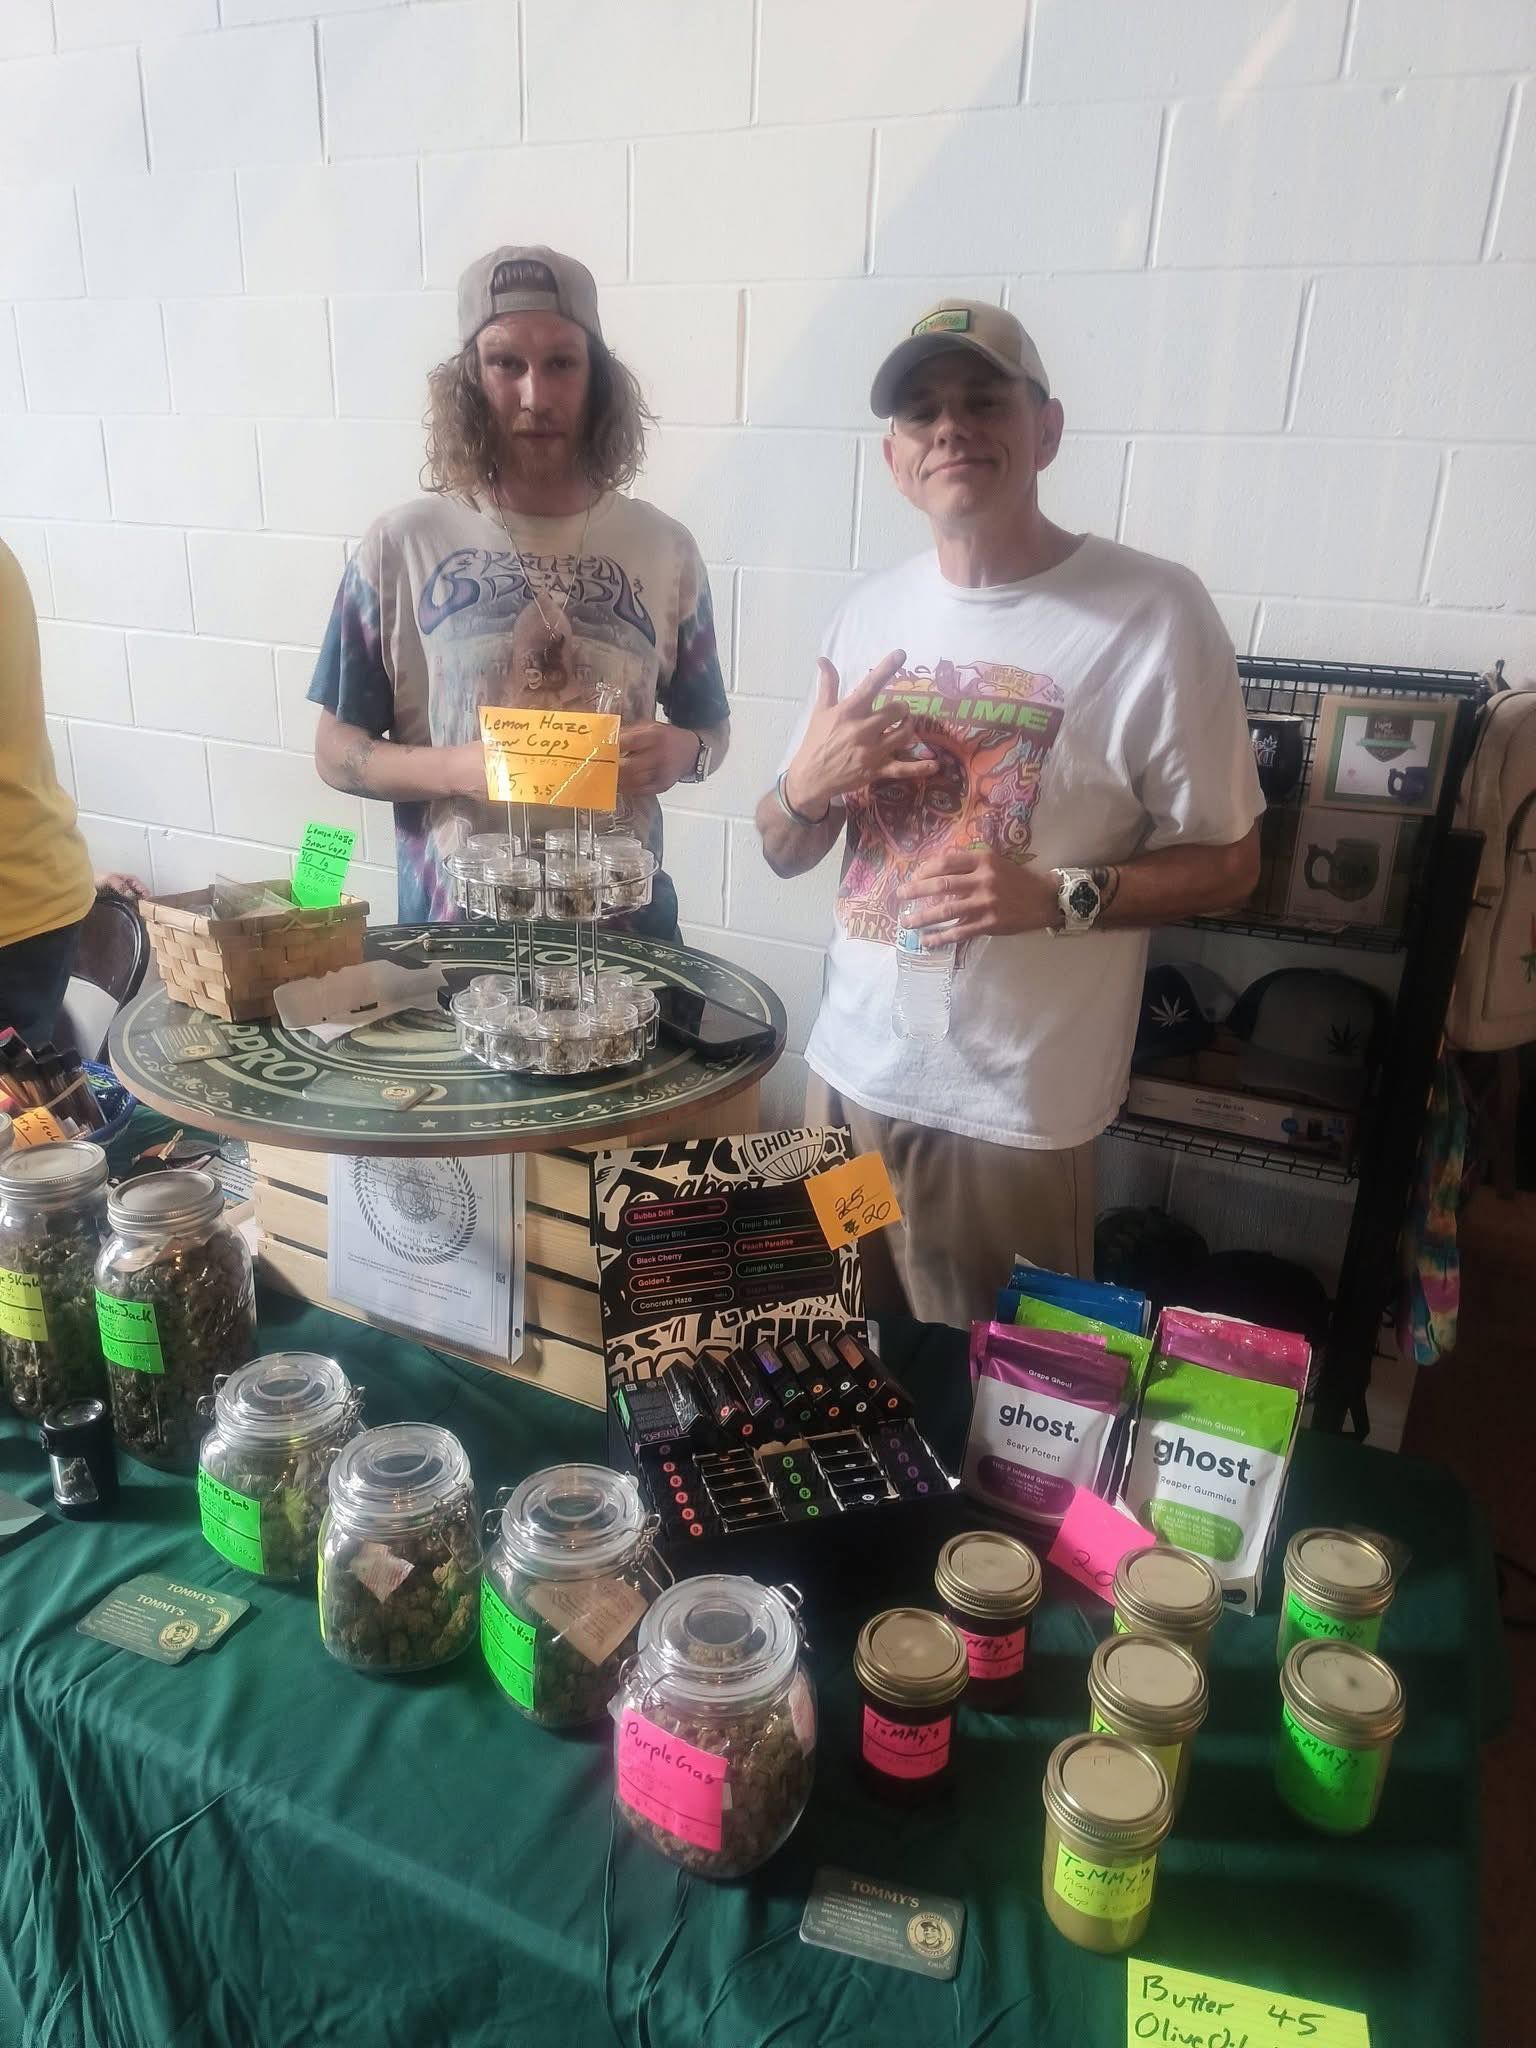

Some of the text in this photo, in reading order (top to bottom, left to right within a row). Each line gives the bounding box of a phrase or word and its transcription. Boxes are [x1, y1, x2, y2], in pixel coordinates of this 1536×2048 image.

[485, 714, 530, 731] Lemon
[527, 733, 570, 755] Caps
[633, 1212, 657, 1220] Bubba
[861, 1201, 891, 1225] 20
[764, 1238, 794, 1248] Paradise
[636, 1252, 682, 1265] Black Cherry
[637, 1277, 665, 1287] Golden
[640, 1296, 693, 1310] Concrete Haze
[1028, 1368, 1073, 1390] Grape Ghoul
[998, 1403, 1080, 1444] ghost.
[1006, 1438, 1061, 1463] Scary Potent
[1153, 1437, 1256, 1488] ghost.
[1160, 1476, 1238, 1506] Reaper Gummies
[167, 1583, 218, 1605] TOMMY'S
[136, 1594, 188, 1617] TOMMY'S
[625, 1721, 672, 1764] Purple
[850, 1880, 920, 1909] TOMMY'S
[1142, 1975, 1327, 2036] Butter 45
